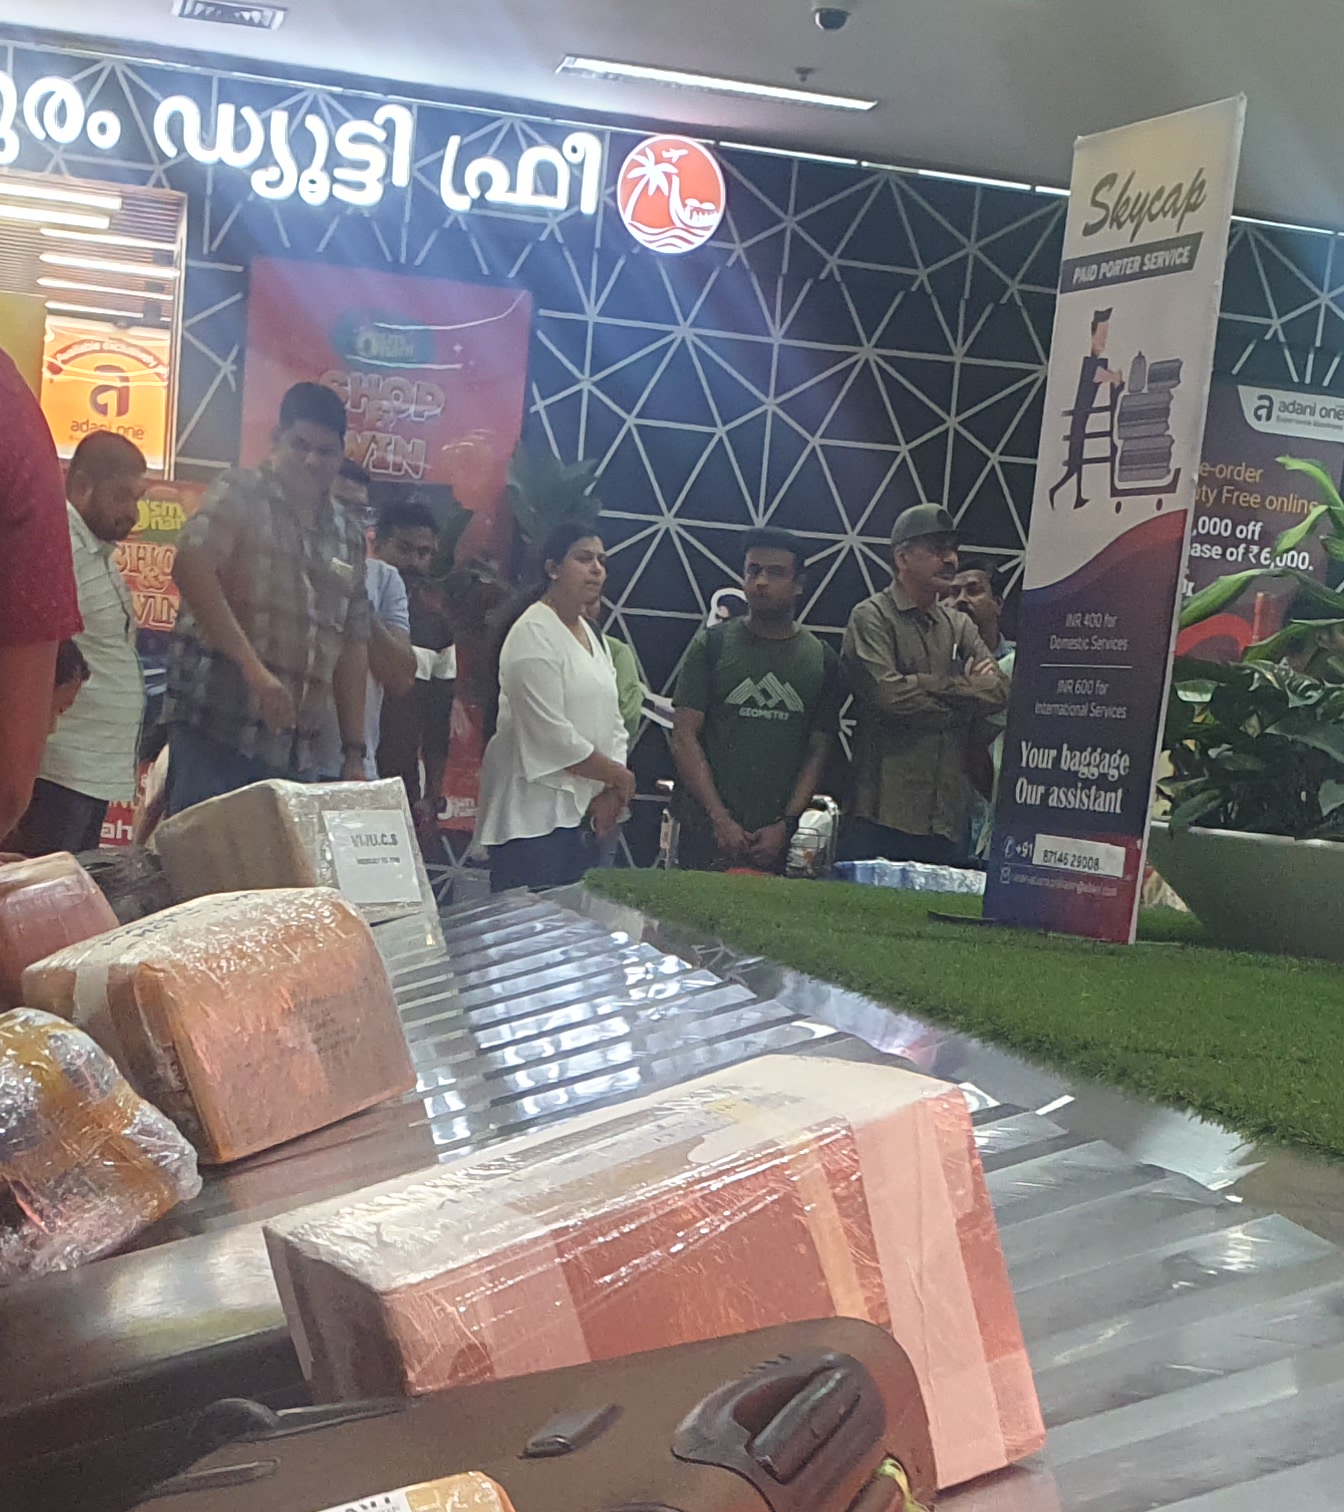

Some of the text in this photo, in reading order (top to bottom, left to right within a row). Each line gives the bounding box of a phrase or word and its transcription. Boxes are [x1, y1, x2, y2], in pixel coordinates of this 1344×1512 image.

[1082, 167, 1206, 243] Skycap
[1073, 246, 1191, 284] PAID PORTER SERVICE
[1278, 399, 1316, 415] adani
[1222, 486, 1261, 507] Free
[1235, 522, 1264, 541] off
[1226, 544, 1247, 562] of
[1065, 613, 1117, 627] INR 400 for
[1049, 634, 1129, 651] Domestic Services
[1057, 679, 1110, 695] INR 600 for
[1035, 700, 1127, 718] International Services
[1020, 740, 1130, 781] Your baggage
[1015, 777, 1123, 814] Our assistant
